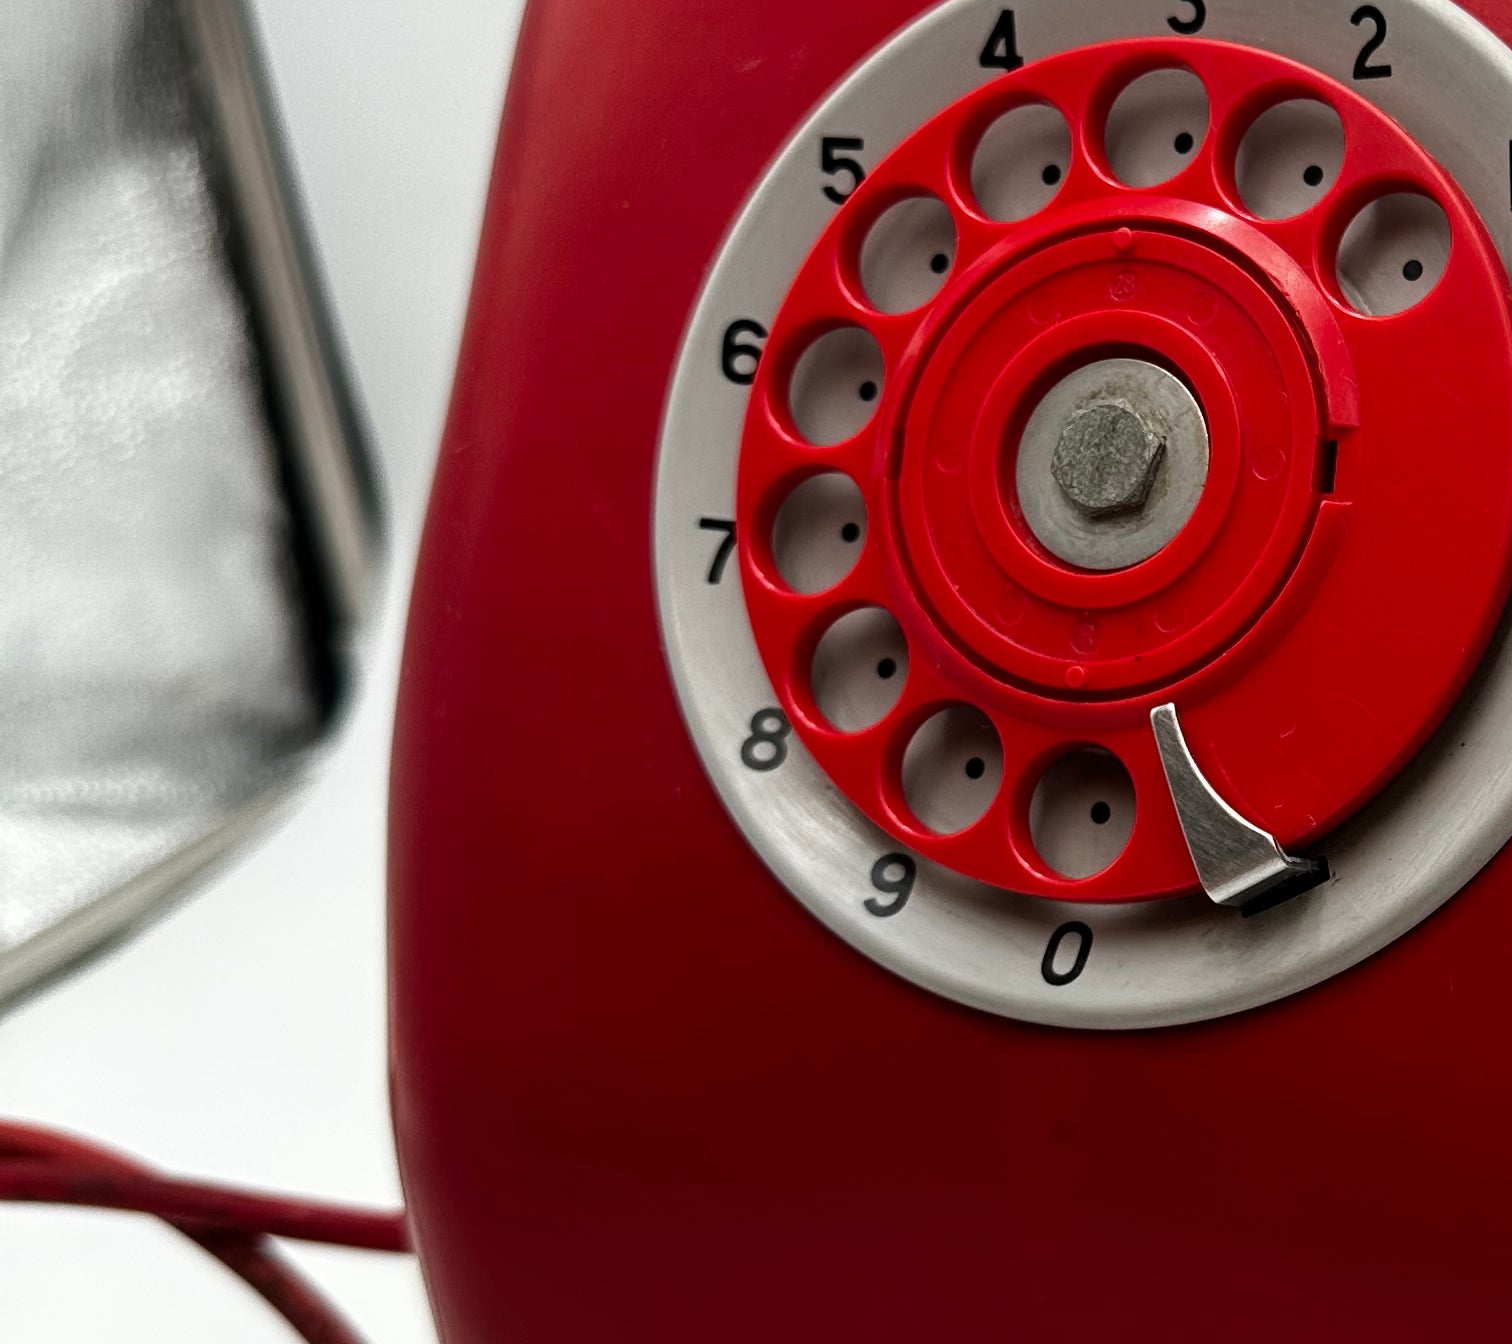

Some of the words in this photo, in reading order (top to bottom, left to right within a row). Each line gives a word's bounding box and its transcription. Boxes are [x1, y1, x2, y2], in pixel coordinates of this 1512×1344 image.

[977, 6, 1025, 72] 4
[1349, 3, 1394, 82] 2
[819, 135, 867, 205] 5
[719, 318, 765, 387] 6
[697, 517, 738, 586] 7
[739, 706, 793, 774] 8
[862, 851, 920, 920] 9
[1040, 920, 1096, 988] 0
